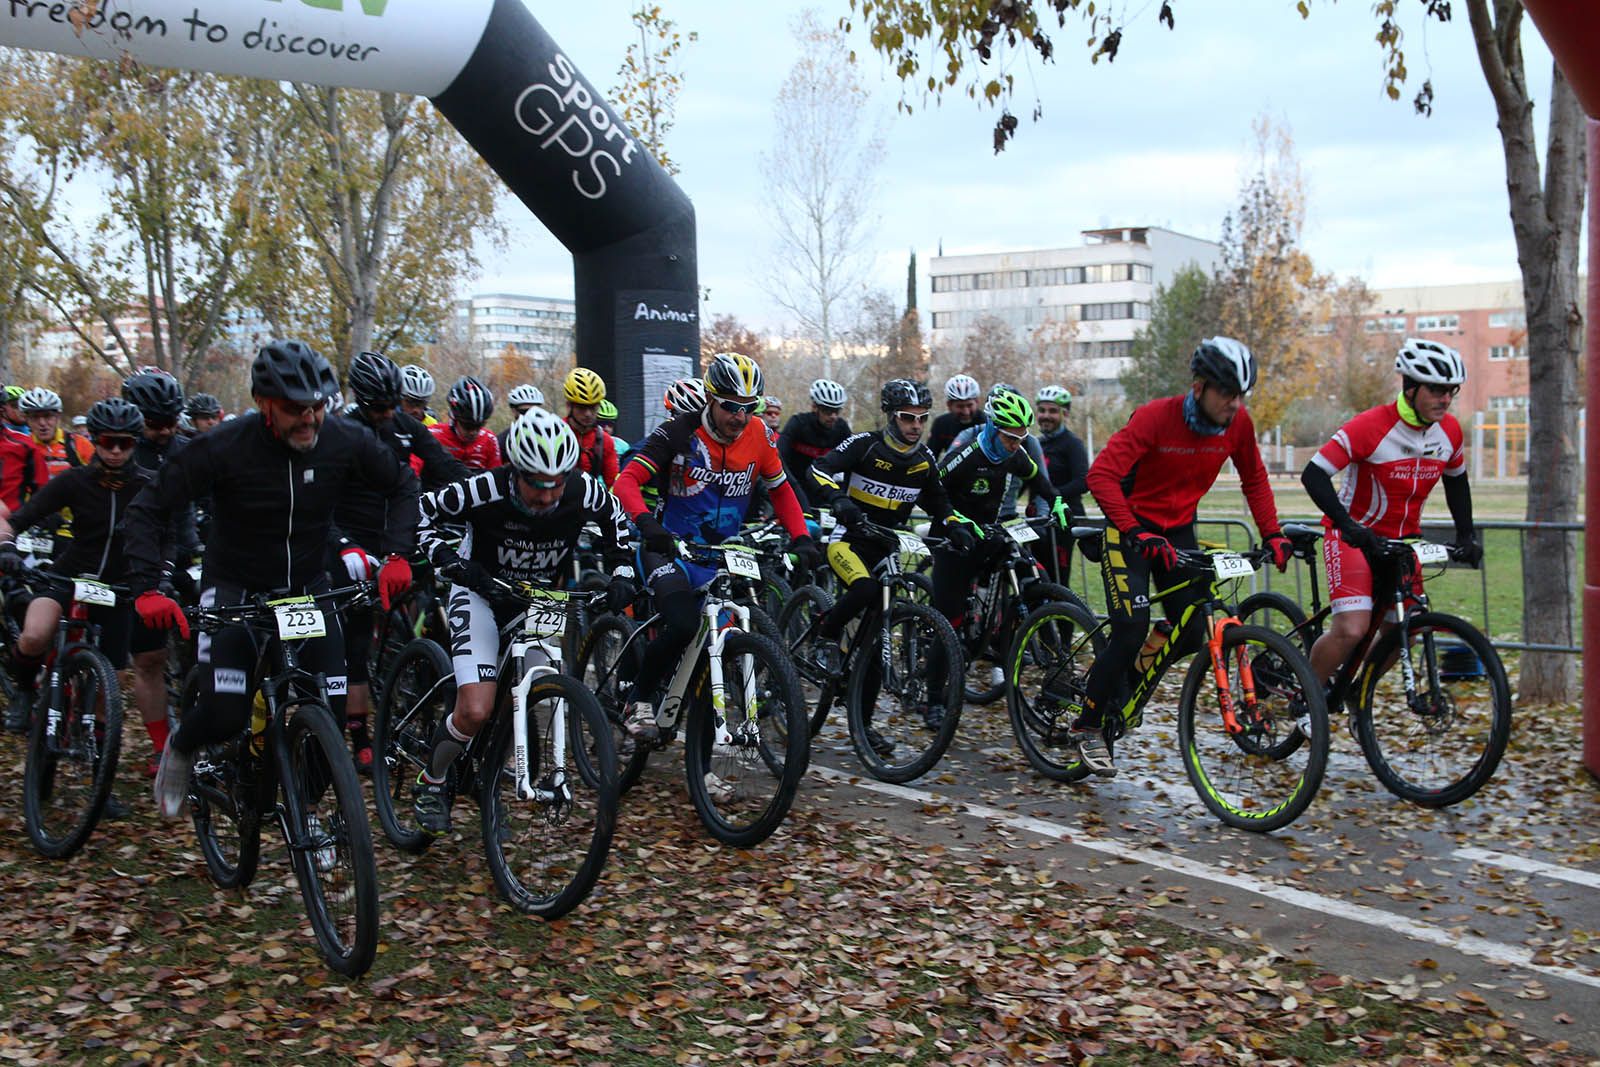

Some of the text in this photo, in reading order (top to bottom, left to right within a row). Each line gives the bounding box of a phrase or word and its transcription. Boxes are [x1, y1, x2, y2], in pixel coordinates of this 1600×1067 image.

[183, 8, 228, 42] to
[242, 17, 381, 61] discover
[514, 83, 622, 199] GPS
[874, 458, 893, 472] RR
[1390, 471, 1411, 480] SANT
[724, 481, 752, 498] bike
[861, 479, 886, 498] RR
[732, 557, 755, 571] 149
[1221, 559, 1244, 571] 187
[285, 611, 317, 627] 223
[534, 610, 561, 626] 222
[479, 667, 496, 678] W2
